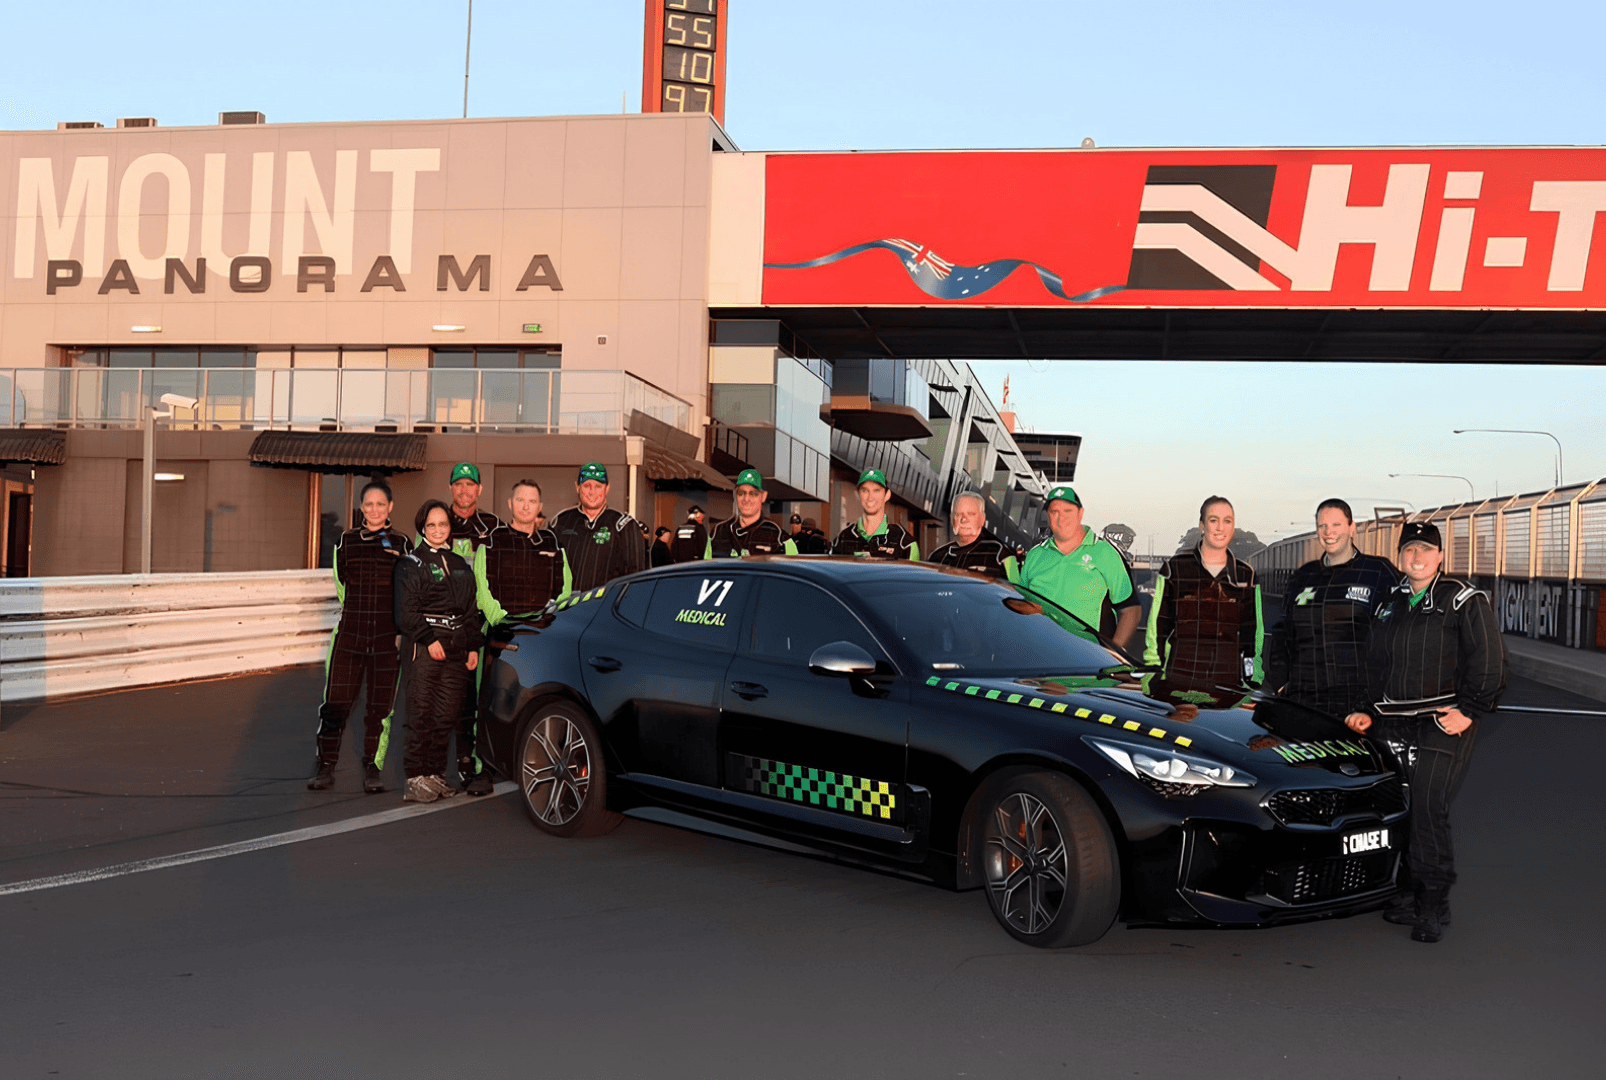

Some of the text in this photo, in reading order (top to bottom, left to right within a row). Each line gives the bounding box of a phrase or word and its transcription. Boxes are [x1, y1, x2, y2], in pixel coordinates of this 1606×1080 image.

[668, 14, 711, 48] 55
[680, 52, 712, 83] 10
[665, 84, 711, 113] 97
[14, 147, 441, 279] MOUNT
[46, 254, 564, 296] PANORAMA
[697, 578, 734, 607] V1
[675, 608, 726, 627] MEDICAL
[1271, 739, 1370, 764] MEDICAL
